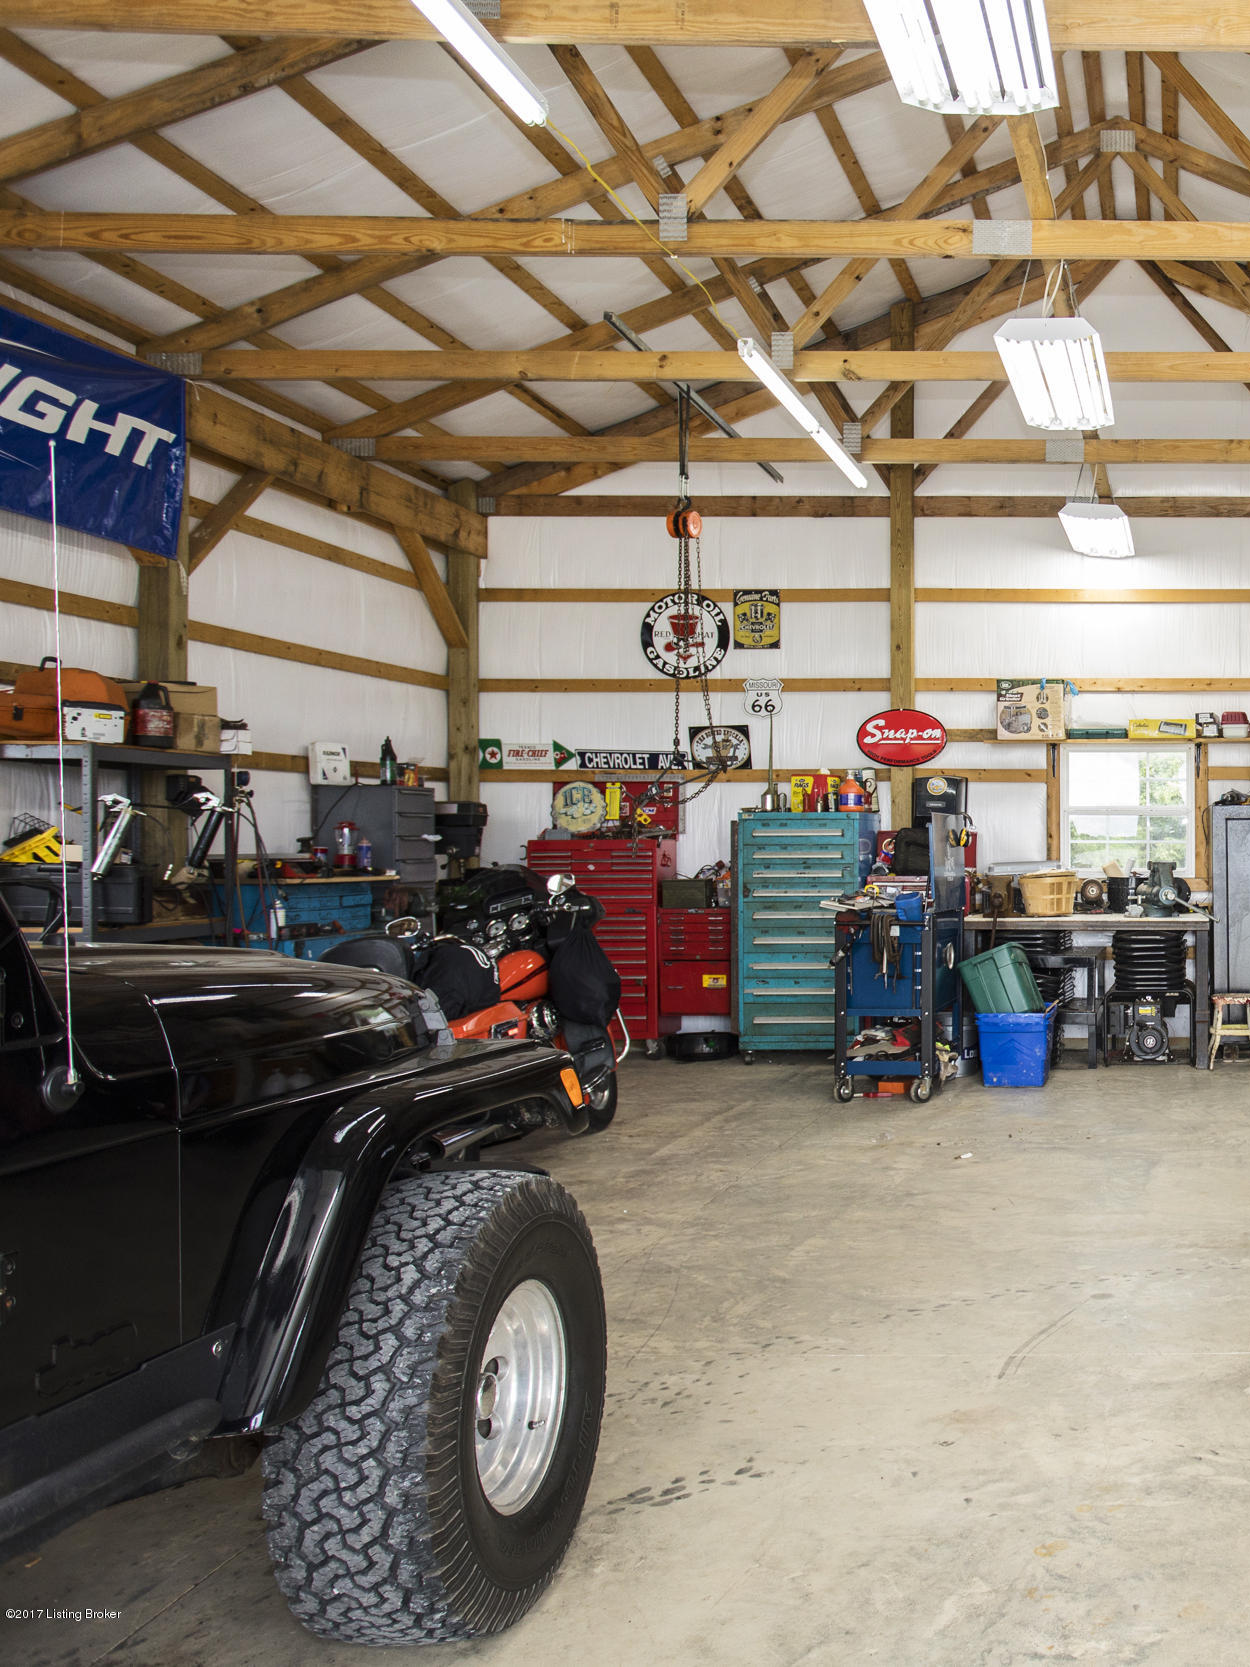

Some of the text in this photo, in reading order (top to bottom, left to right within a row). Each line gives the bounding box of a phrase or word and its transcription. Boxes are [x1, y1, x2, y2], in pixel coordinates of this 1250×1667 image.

[736, 591, 779, 605] Genuine Parts
[645, 593, 726, 626] MOTOR OIL
[654, 630, 671, 638] RED
[646, 646, 725, 677] GASOLINE
[748, 681, 778, 689] MISSOURI
[751, 698, 775, 713] 66
[863, 719, 942, 744] Snap-on
[584, 752, 650, 769] CHEVROLET
[562, 786, 592, 807] ICE
